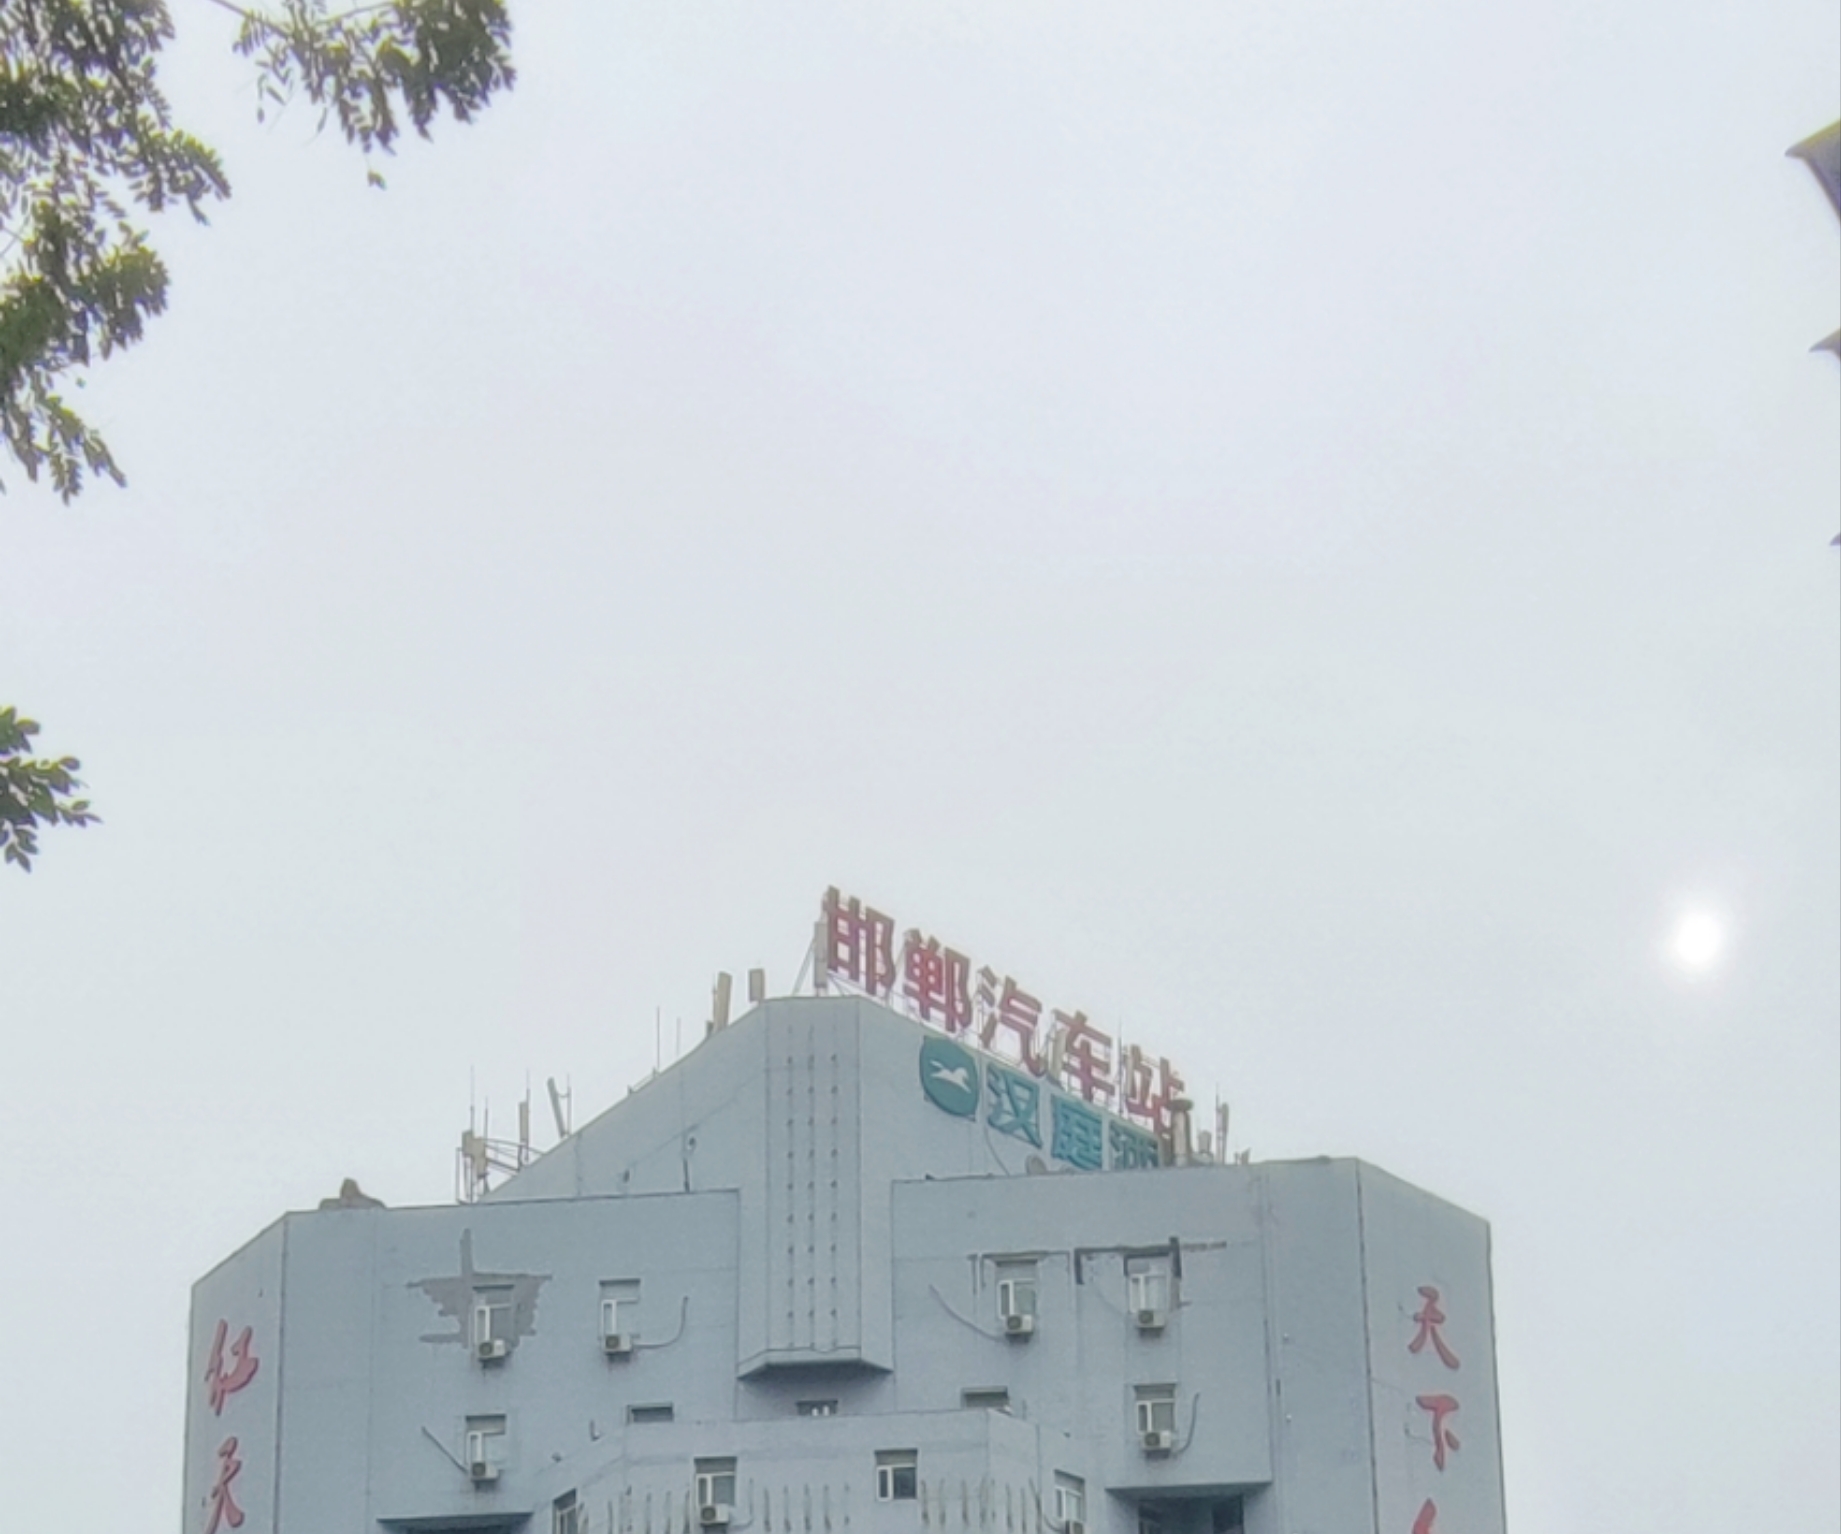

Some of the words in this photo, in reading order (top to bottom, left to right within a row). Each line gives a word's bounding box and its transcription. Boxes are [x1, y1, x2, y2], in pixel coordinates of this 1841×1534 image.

[821, 885, 1186, 1144] 邯郸汽车站
